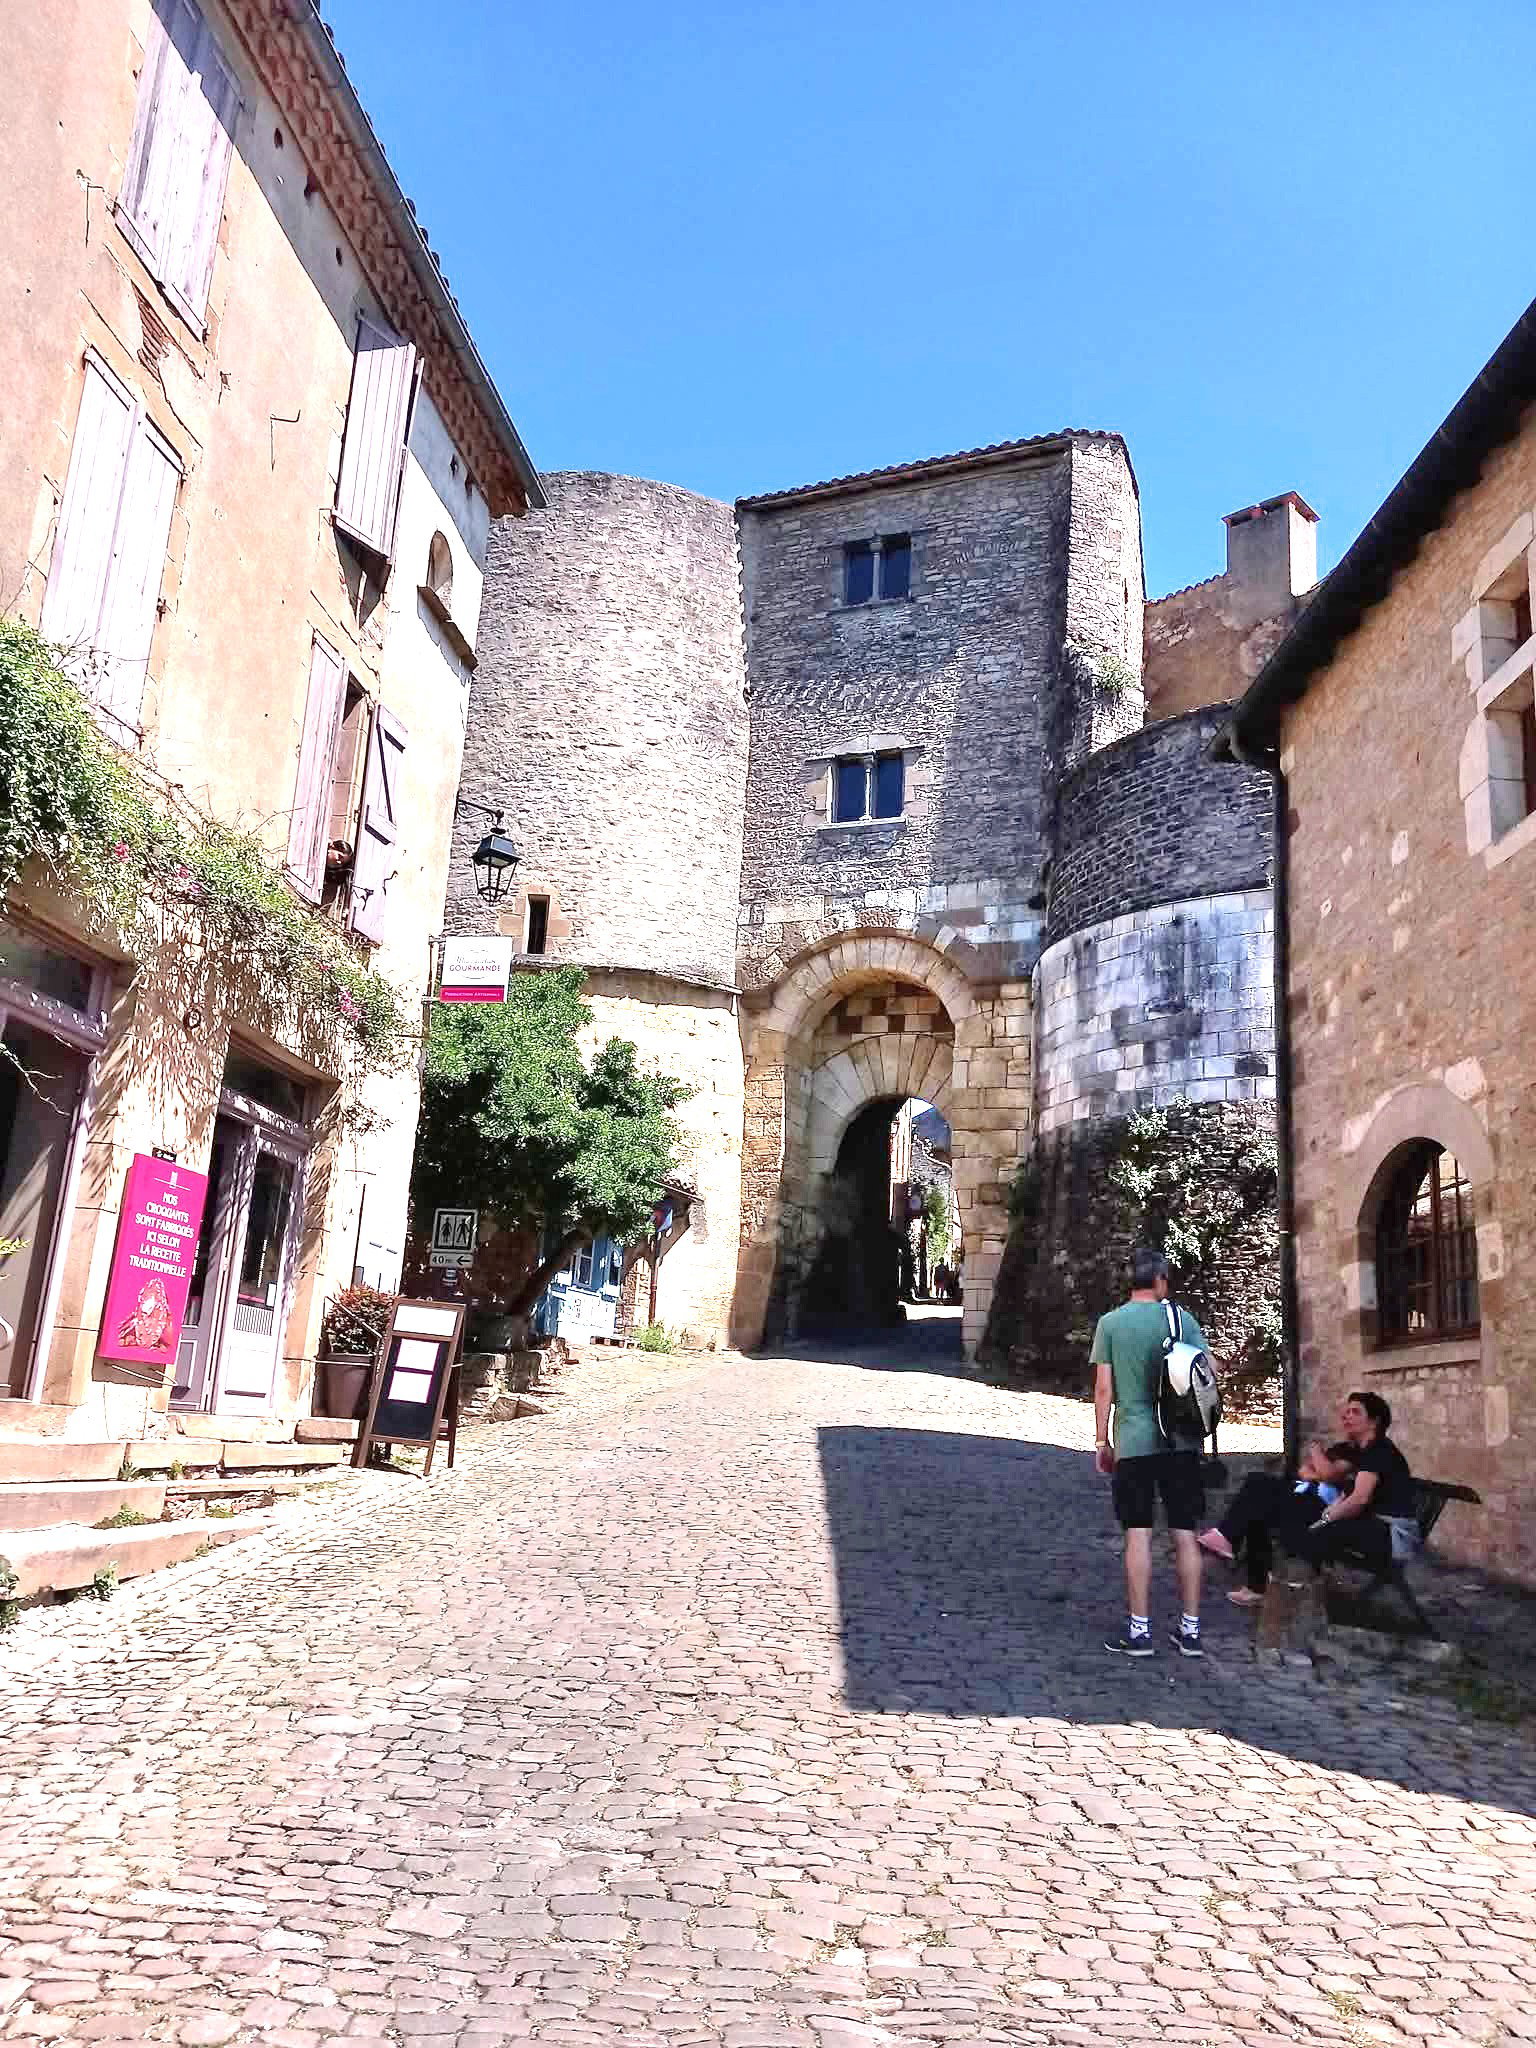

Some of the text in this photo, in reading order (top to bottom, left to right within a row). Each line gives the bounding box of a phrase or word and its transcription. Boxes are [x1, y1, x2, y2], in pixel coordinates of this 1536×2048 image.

[449, 964, 501, 972] GOURMANDE
[163, 1192, 178, 1206] NOS
[146, 1202, 190, 1223] CROQUANTS
[135, 1212, 194, 1239] SONT FABRIQUÉS
[146, 1230, 180, 1248] ICI SELON
[140, 1243, 151, 1255] LA
[151, 1245, 181, 1262] RECETTE
[129, 1255, 187, 1277] TRADITIONNELLE
